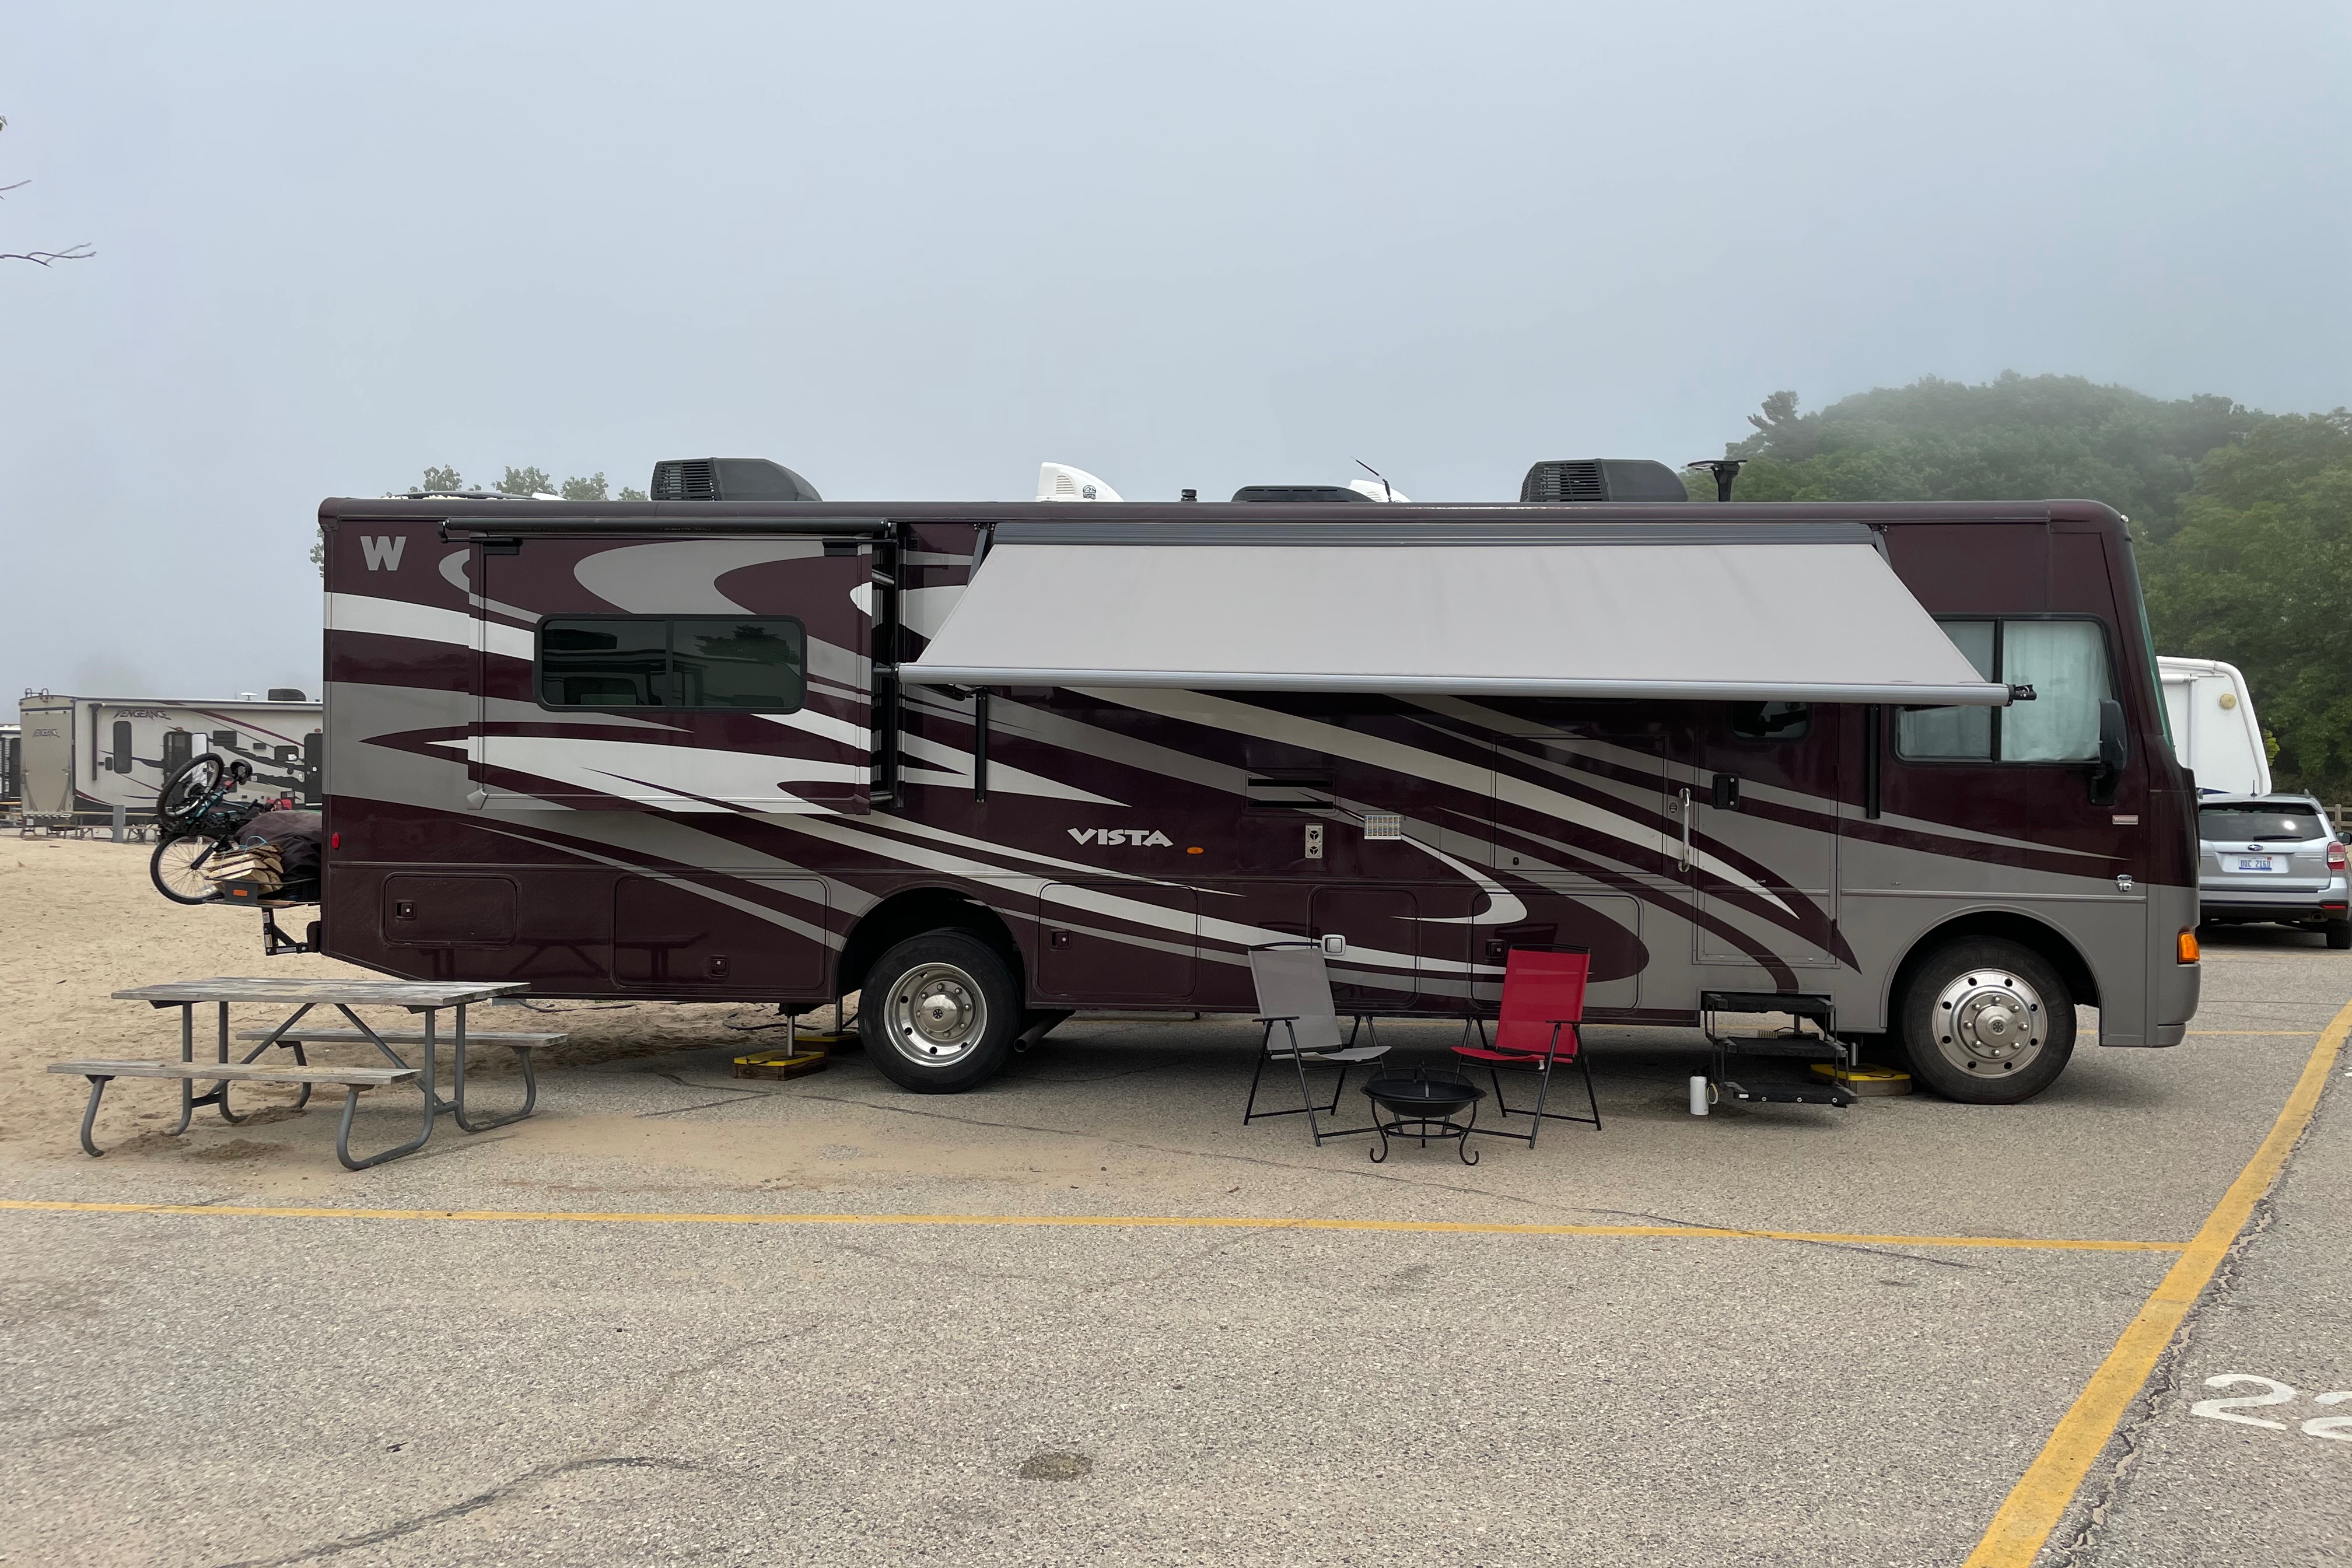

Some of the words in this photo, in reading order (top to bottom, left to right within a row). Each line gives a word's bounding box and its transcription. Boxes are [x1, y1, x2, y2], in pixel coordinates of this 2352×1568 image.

[360, 536, 407, 571] W
[113, 709, 172, 721] VENGEANCE
[1067, 828, 1174, 847] VISTA
